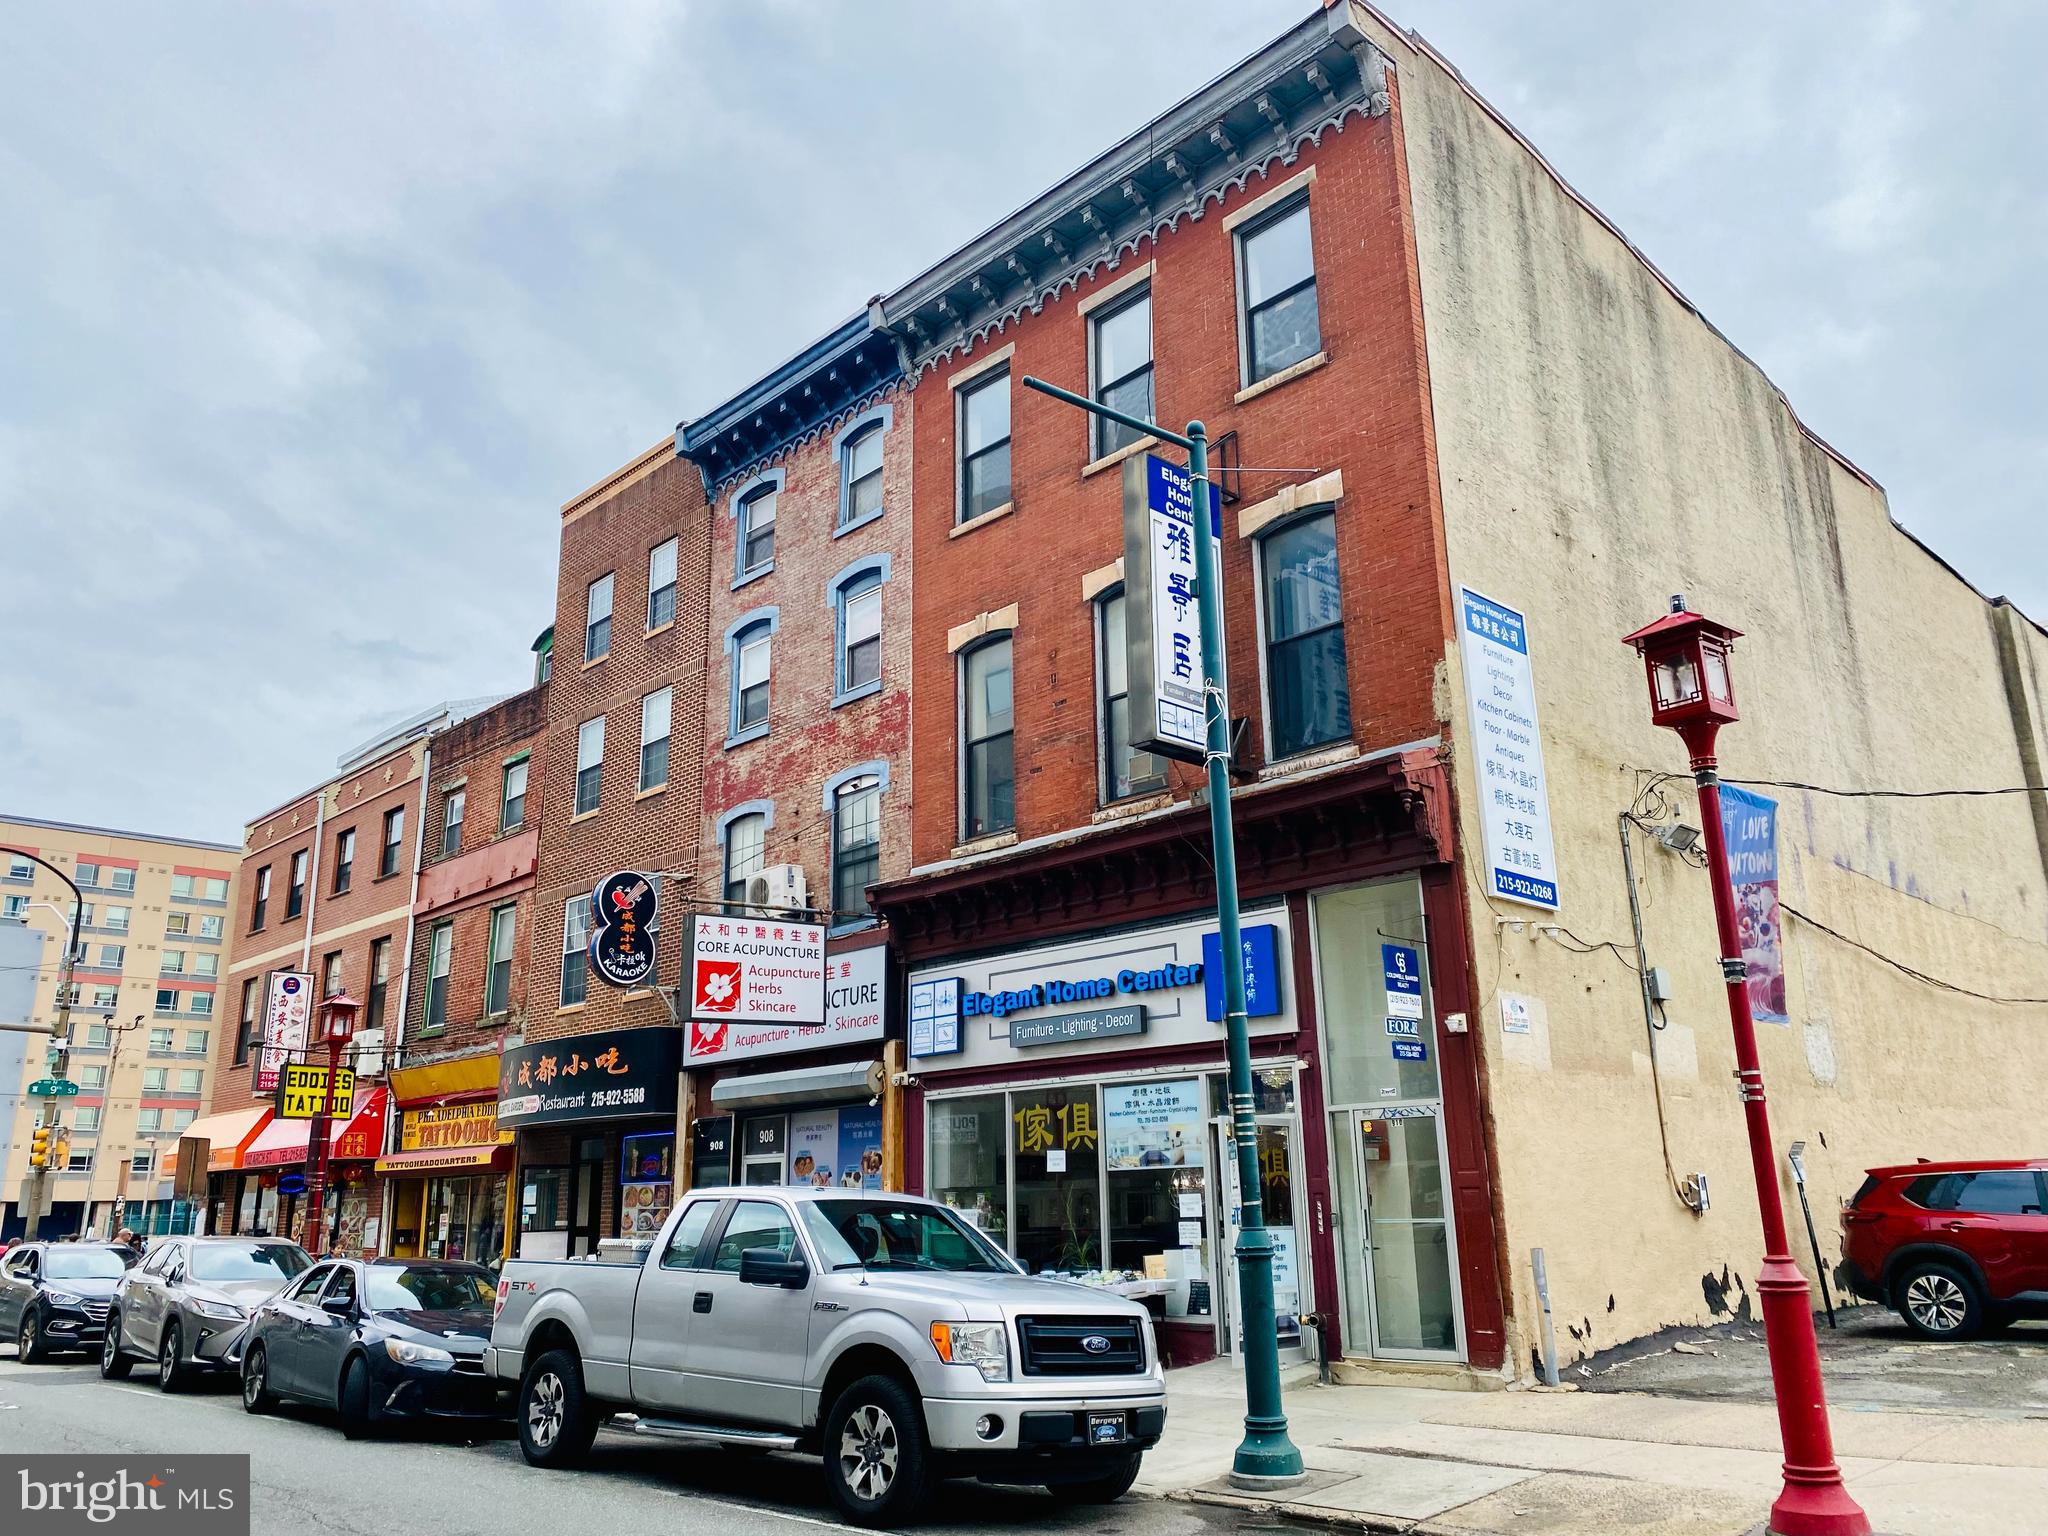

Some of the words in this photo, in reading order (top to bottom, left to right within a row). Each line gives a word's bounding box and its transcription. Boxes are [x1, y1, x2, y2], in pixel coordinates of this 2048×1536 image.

[1161, 466, 1192, 492] Elega
[1168, 486, 1192, 507] Hom
[1165, 501, 1194, 524] Cent
[1463, 594, 1486, 613] Elegant
[1486, 604, 1503, 621] Home
[1503, 613, 1521, 629] Center
[1482, 644, 1514, 667] Furniture
[1487, 664, 1515, 688] Lighting
[1493, 685, 1513, 702] Decor
[1477, 699, 1503, 718] Kitchen
[1503, 708, 1533, 729] Cabinets
[1484, 720, 1502, 736] Floor
[1506, 728, 1530, 746] Marble
[1495, 743, 1525, 763] Antiques
[1504, 819, 1533, 841] 大理石
[1742, 815, 1769, 840] LOVE
[1502, 845, 1542, 870] 古董物品
[1497, 874, 1553, 901] 215-922-0268
[698, 922, 820, 944] 太和中醫養生堂
[697, 940, 730, 954] CORE
[732, 943, 820, 960] ACUPUNCTURE
[603, 958, 648, 977] KARAOKE
[748, 965, 821, 980] Acupuncture
[748, 982, 782, 995] Herbs
[962, 987, 1043, 1018] Elegant
[1045, 976, 1116, 1005] Home
[1117, 963, 1204, 992] Center
[748, 999, 797, 1013] Skincare
[272, 994, 289, 1063] 西安美食
[735, 1028, 790, 1049] Acupuncture
[798, 1025, 826, 1037] Herbs
[834, 1012, 879, 1031] Skincare
[1016, 1024, 1054, 1040] Furniture
[1061, 1016, 1097, 1036] Lighting
[1105, 1013, 1134, 1029] Decor
[1388, 1019, 1410, 1034] FOR
[517, 1047, 629, 1089] 成都小吃
[67, 1087, 76, 1095] St
[287, 1071, 351, 1090] EDDIES
[286, 1094, 350, 1113] TATTOO
[538, 1090, 586, 1112] Restaurant
[590, 1087, 645, 1108] 215-922-5588
[417, 1106, 475, 1124] PHILADELPHIA
[477, 1103, 497, 1117] EDDI
[418, 1118, 500, 1148] TATTOOING
[759, 1129, 774, 1144] 908
[1013, 1101, 1098, 1153] 傢俱
[709, 1140, 724, 1151] 908
[511, 1281, 536, 1291] STX
